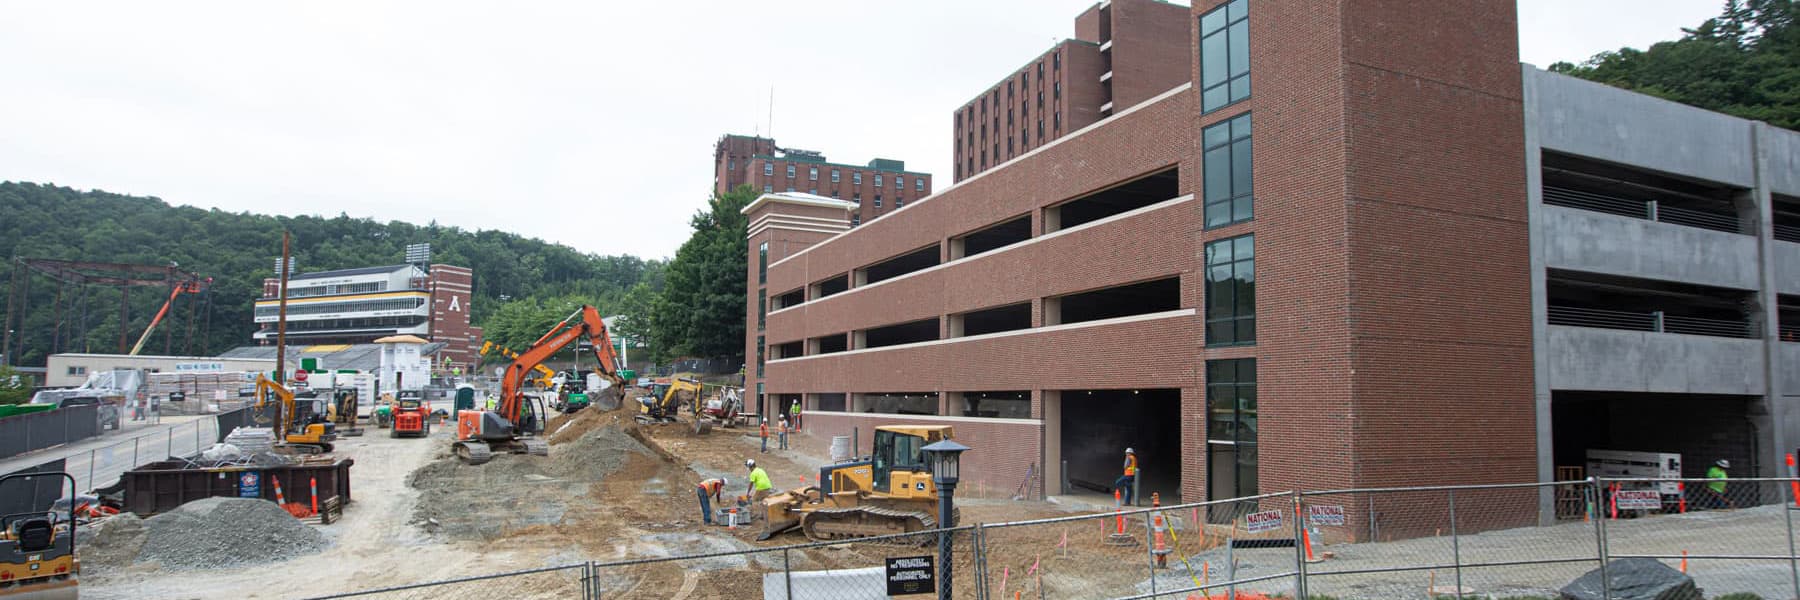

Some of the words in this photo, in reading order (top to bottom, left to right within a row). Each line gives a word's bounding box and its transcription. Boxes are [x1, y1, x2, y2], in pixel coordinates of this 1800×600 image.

[448, 295, 461, 312] A
[1311, 506, 1342, 515] NATIONAL
[1248, 511, 1281, 523] NATIONAL
